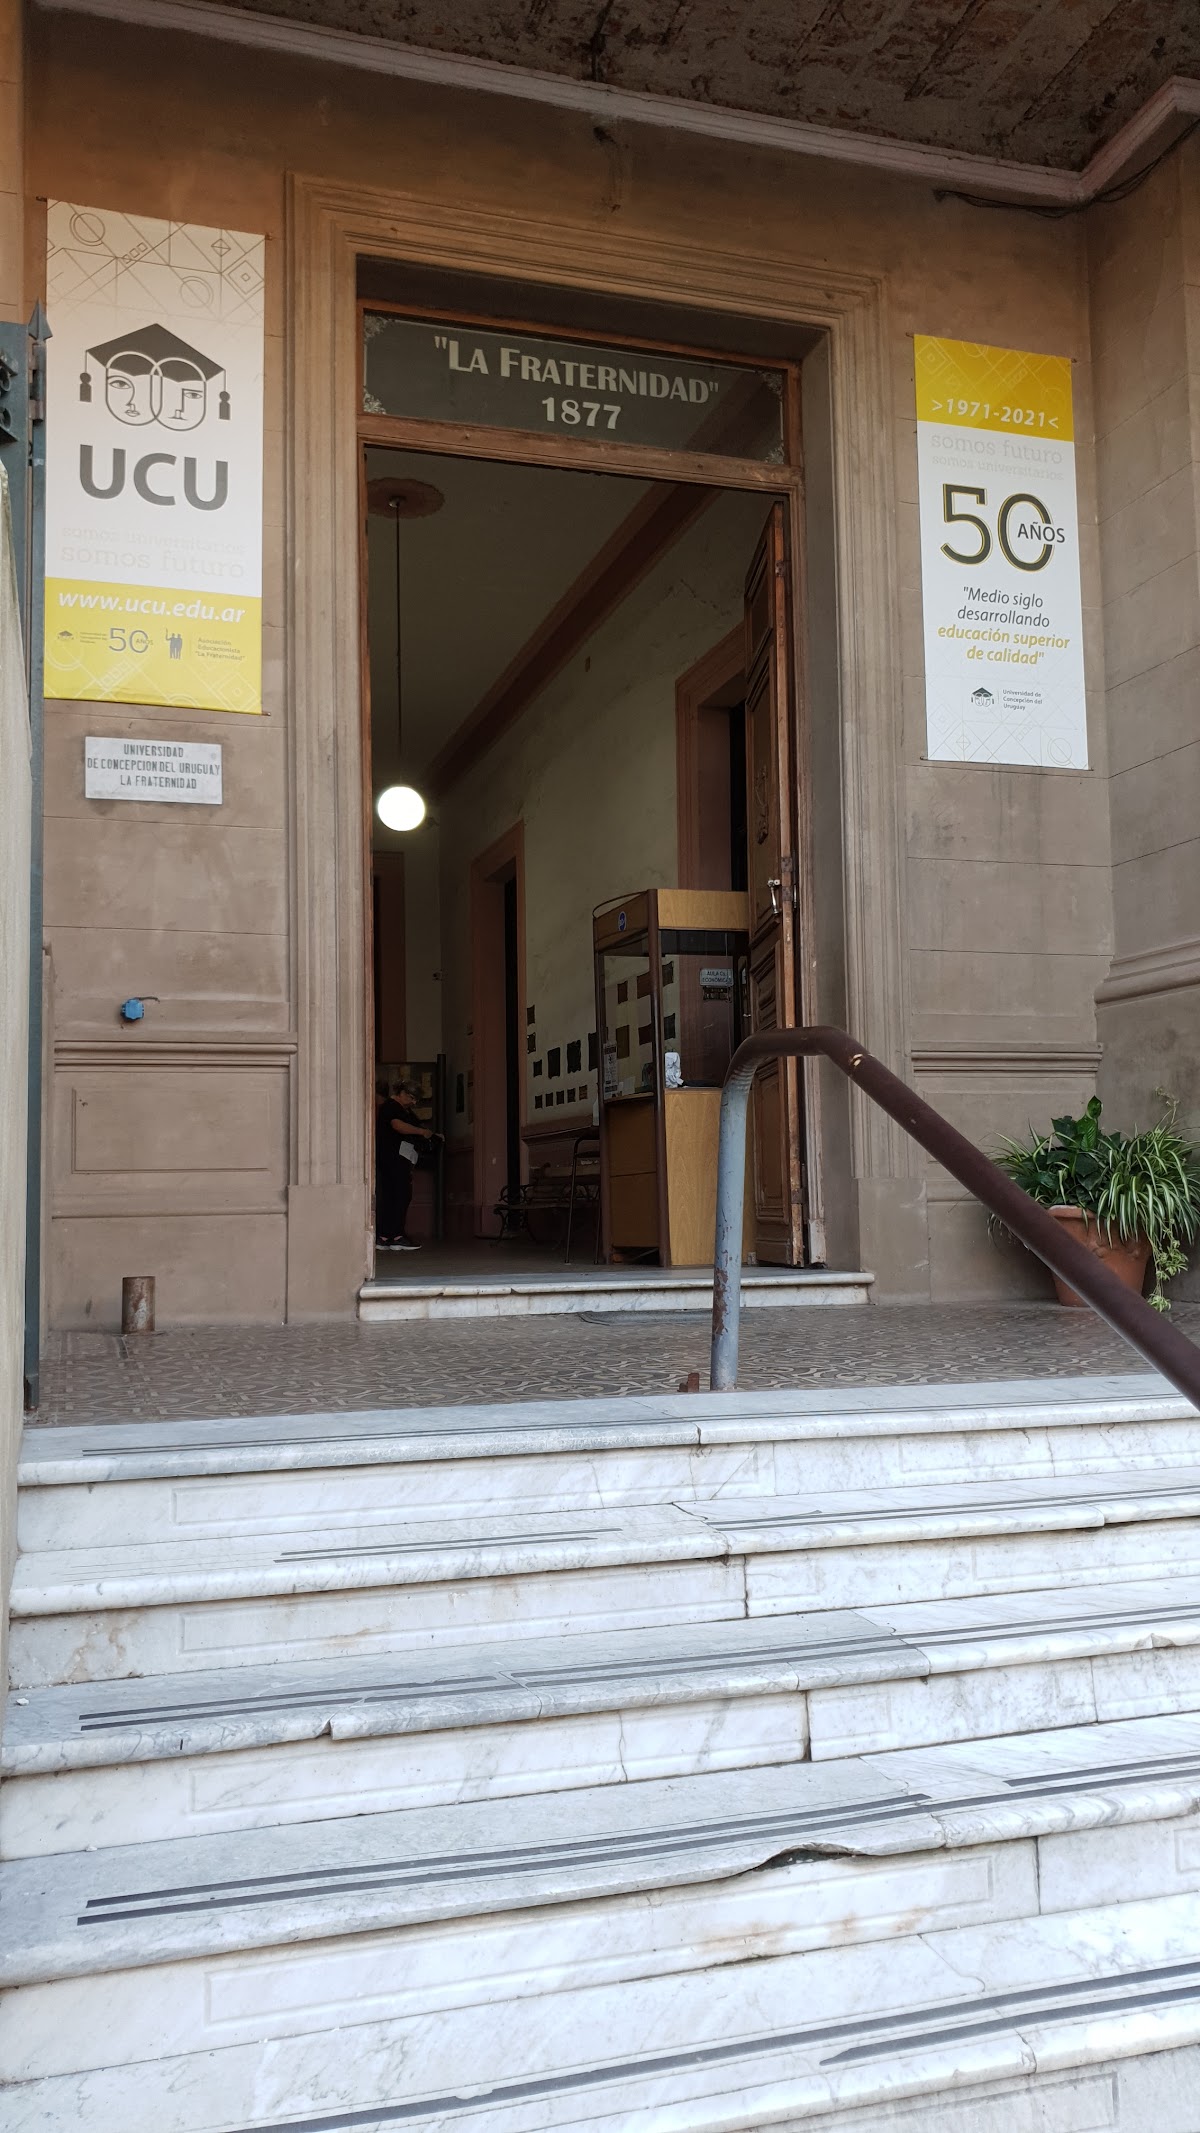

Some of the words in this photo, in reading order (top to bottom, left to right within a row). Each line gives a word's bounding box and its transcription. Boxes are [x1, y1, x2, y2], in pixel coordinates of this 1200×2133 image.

[541, 396, 622, 430] 1877
[931, 434, 996, 456] somos
[1002, 440, 1063, 465] futuro
[80, 443, 228, 511] UCU
[932, 455, 974, 470] somos
[978, 460, 1064, 481] universitarios
[940, 483, 1056, 572] 50
[1017, 521, 1066, 544] AÑOS
[61, 546, 151, 569] somos
[161, 551, 246, 578] futuro
[58, 591, 246, 624] www.ucu.edu.ar
[963, 586, 1010, 605] "Medio
[1012, 592, 1044, 610] siglo
[957, 605, 1051, 628] desarrollando
[108, 627, 149, 654] 50
[937, 624, 1011, 644] educación
[1013, 633, 1071, 650] superior
[966, 645, 984, 660] de
[986, 648, 1046, 665] calidad"
[1002, 689, 1034, 697] Universidad
[1003, 703, 1026, 711] Uruguay
[123, 743, 184, 758] UNIVERSIDAD
[87, 757, 99, 769] DE
[101, 758, 158, 772] CONCEPCION
[160, 761, 176, 773] DEL
[179, 762, 220, 776] URUGUAY
[120, 774, 132, 786] LA
[135, 775, 197, 789] FRATERNIDAD
